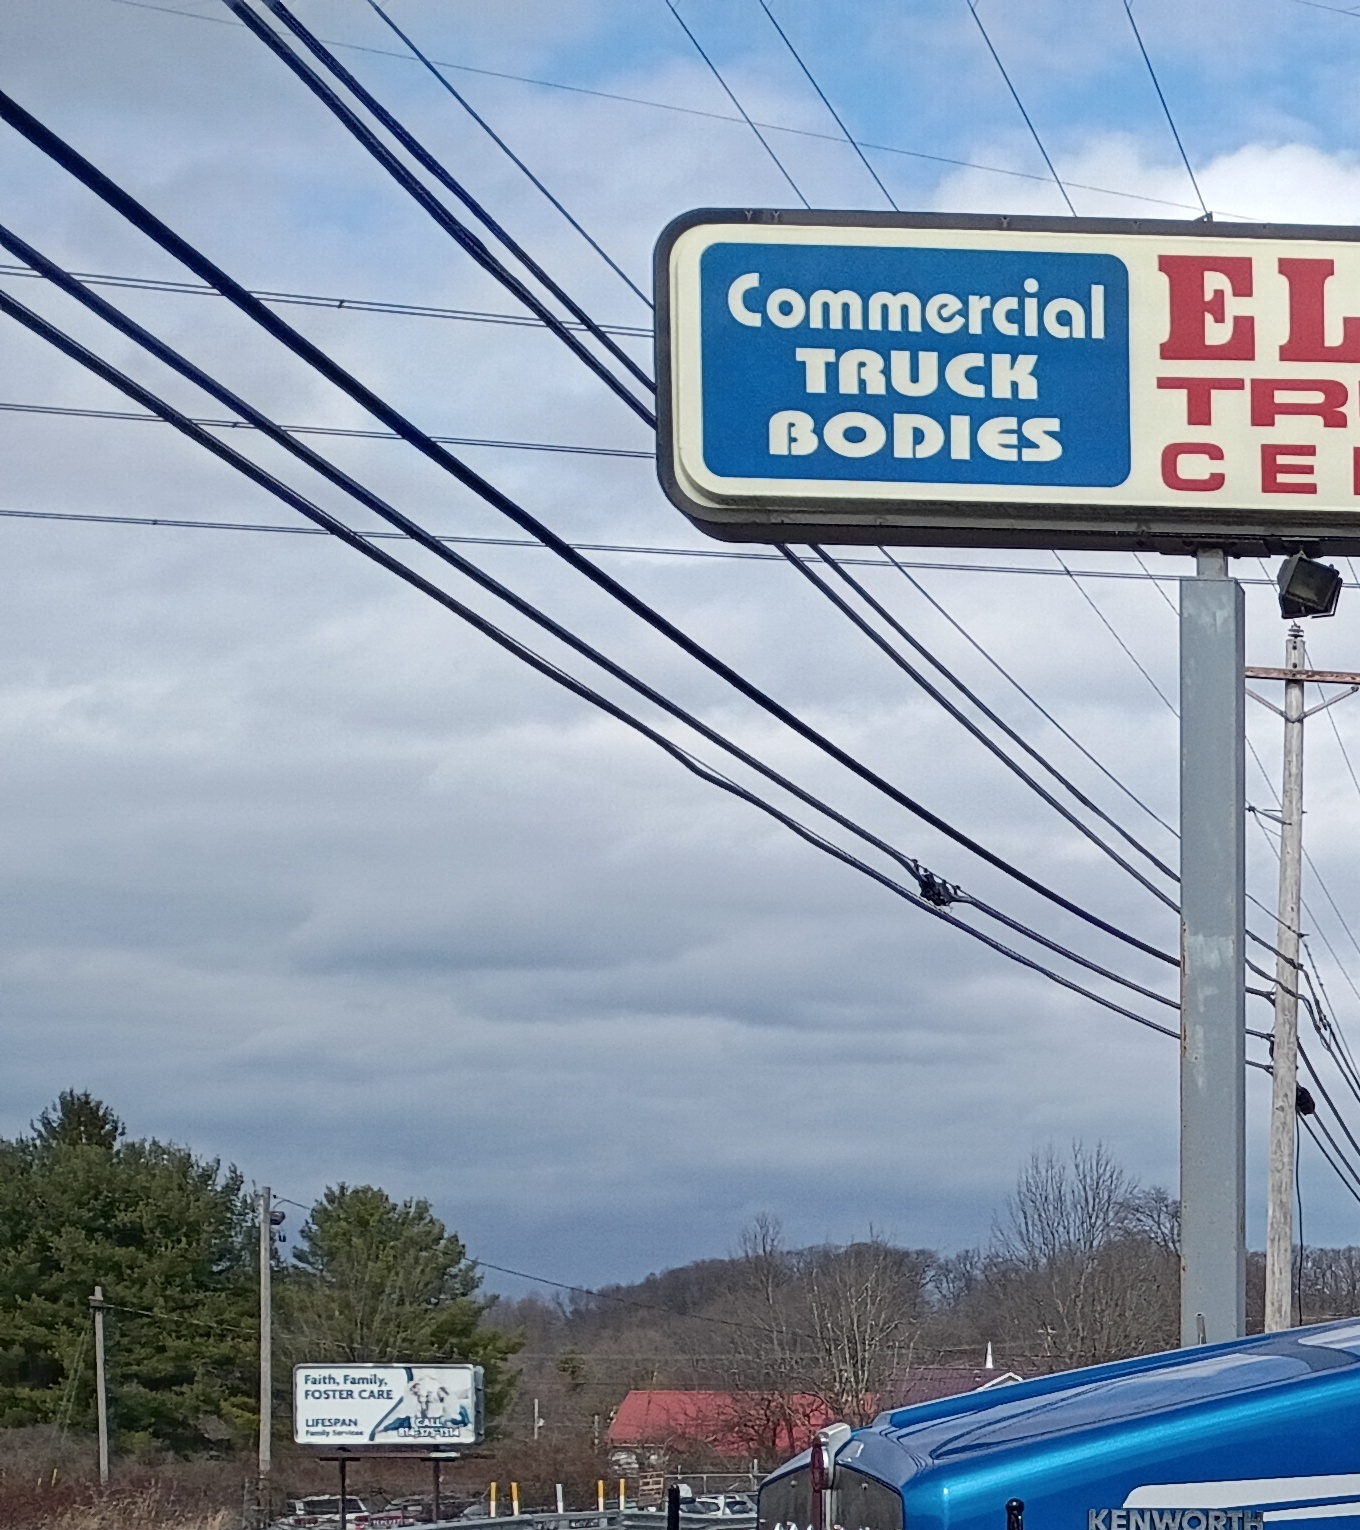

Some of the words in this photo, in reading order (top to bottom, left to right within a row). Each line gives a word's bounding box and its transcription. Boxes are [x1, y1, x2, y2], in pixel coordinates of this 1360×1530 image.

[727, 272, 1107, 341] Commercial
[794, 347, 1039, 401] TRUCK
[768, 411, 1065, 463] BODIES
[304, 1373, 340, 1386] Faith,
[343, 1373, 388, 1387] Family,
[304, 1389, 355, 1400] FOSTER
[358, 1389, 393, 1400] CARE
[305, 1418, 358, 1427] LIFESPAN
[417, 1418, 442, 1426] CALL
